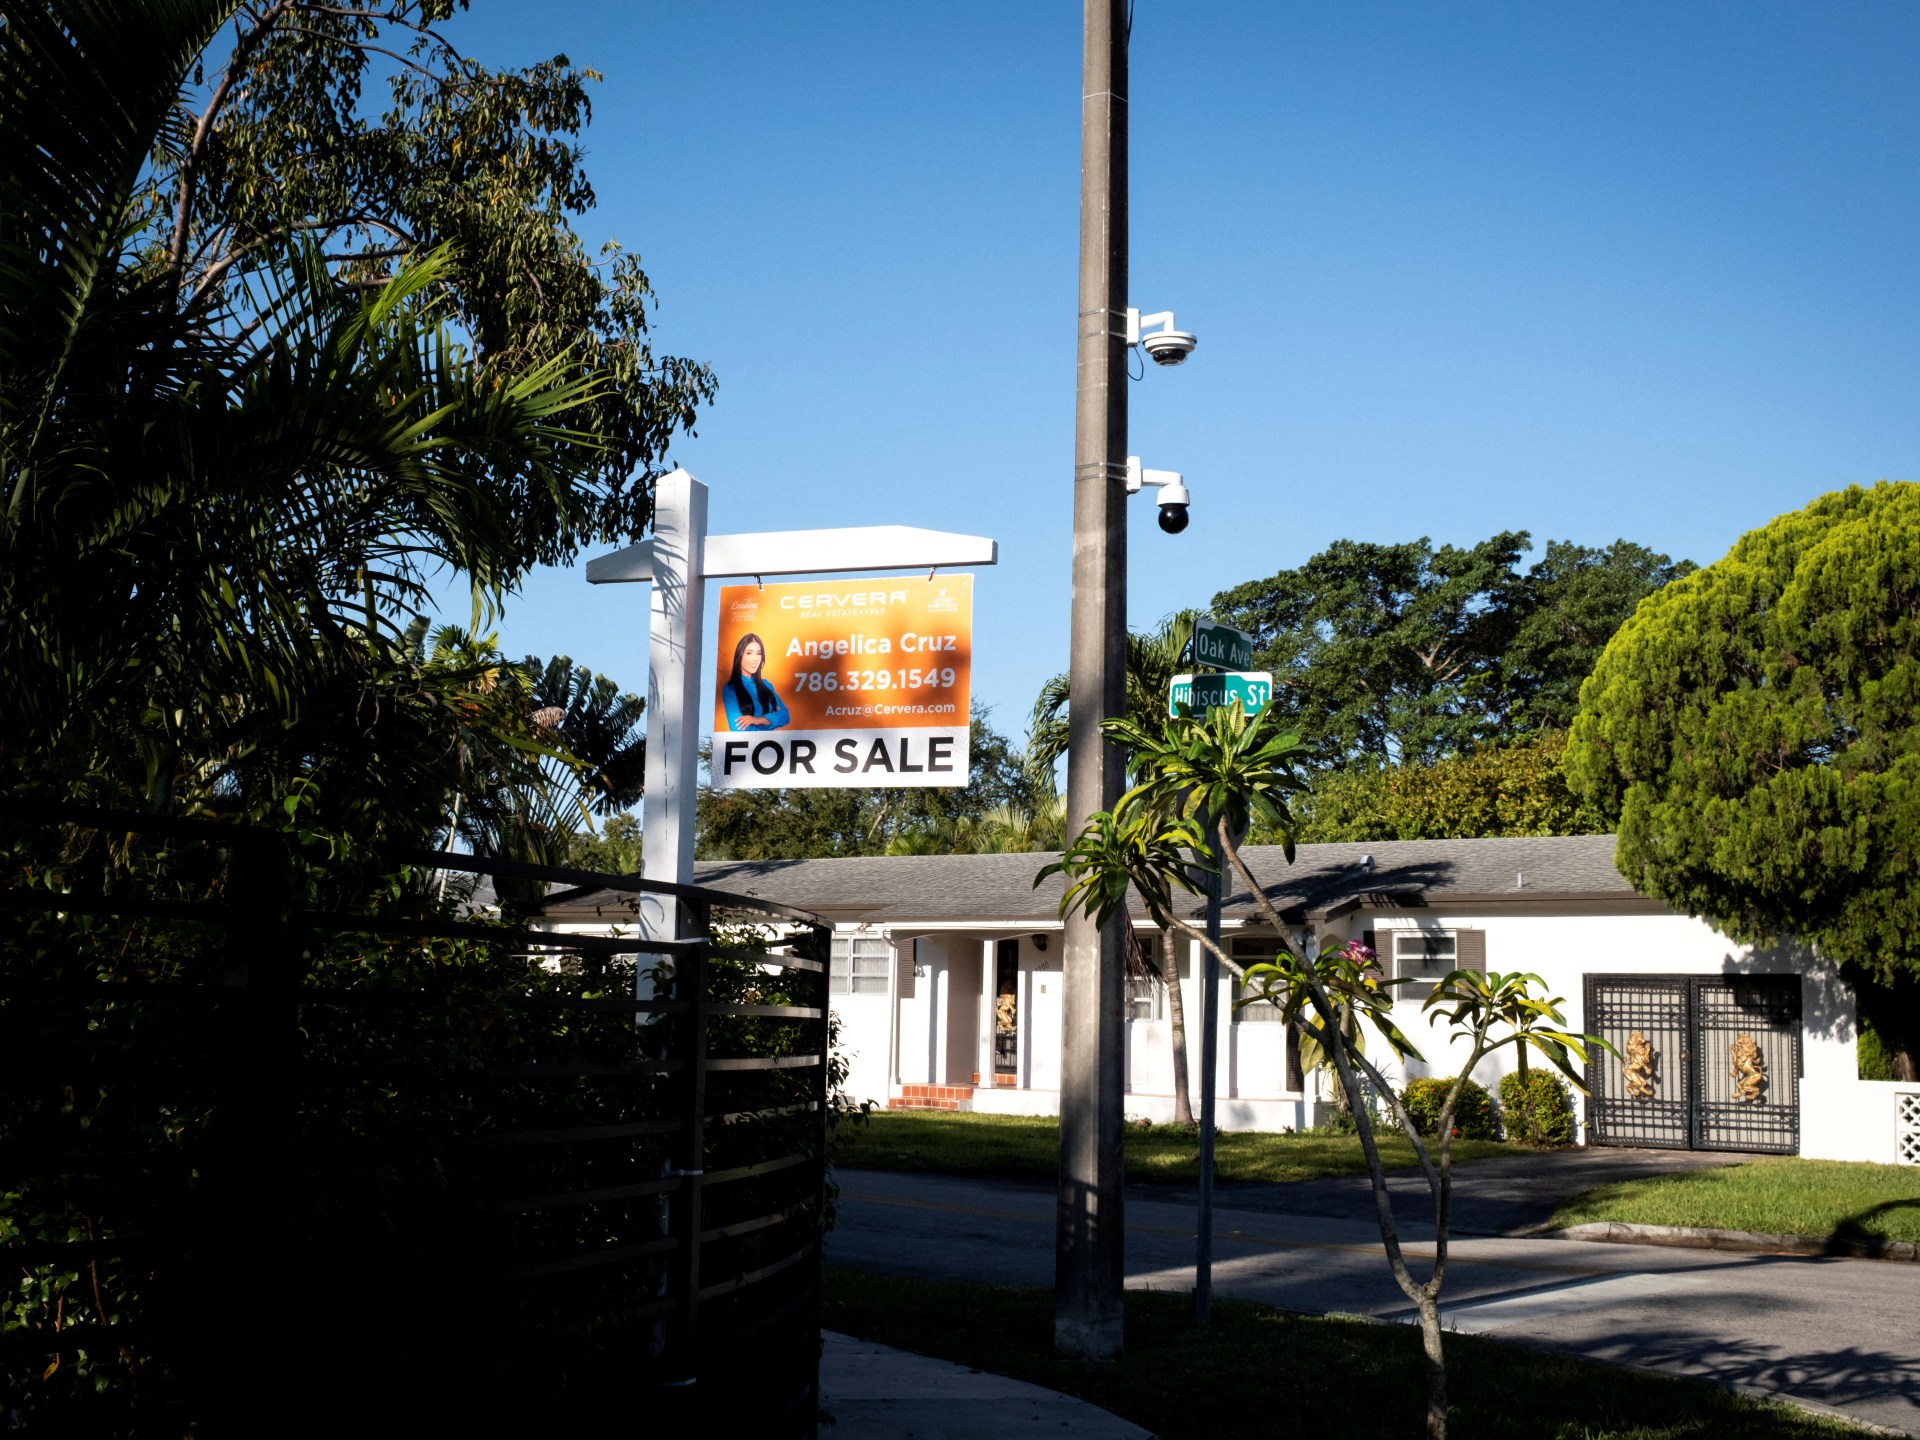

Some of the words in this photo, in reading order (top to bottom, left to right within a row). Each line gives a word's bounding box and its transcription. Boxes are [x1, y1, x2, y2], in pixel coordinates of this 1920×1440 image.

[780, 590, 907, 610] CERVERA
[800, 611, 823, 619] REAL
[826, 609, 857, 617] ESTATE
[786, 634, 891, 659] Angelica
[900, 632, 957, 652] Cruz
[1200, 634, 1225, 659] Oak
[1230, 643, 1250, 666] Ave
[794, 667, 956, 692] 786.329.1549
[1174, 687, 1238, 707] Hibiscus
[1247, 685, 1266, 706] St
[825, 703, 956, 716] Acruz@Cervera.com
[724, 740, 817, 775] FOR
[833, 736, 954, 774] SALE
